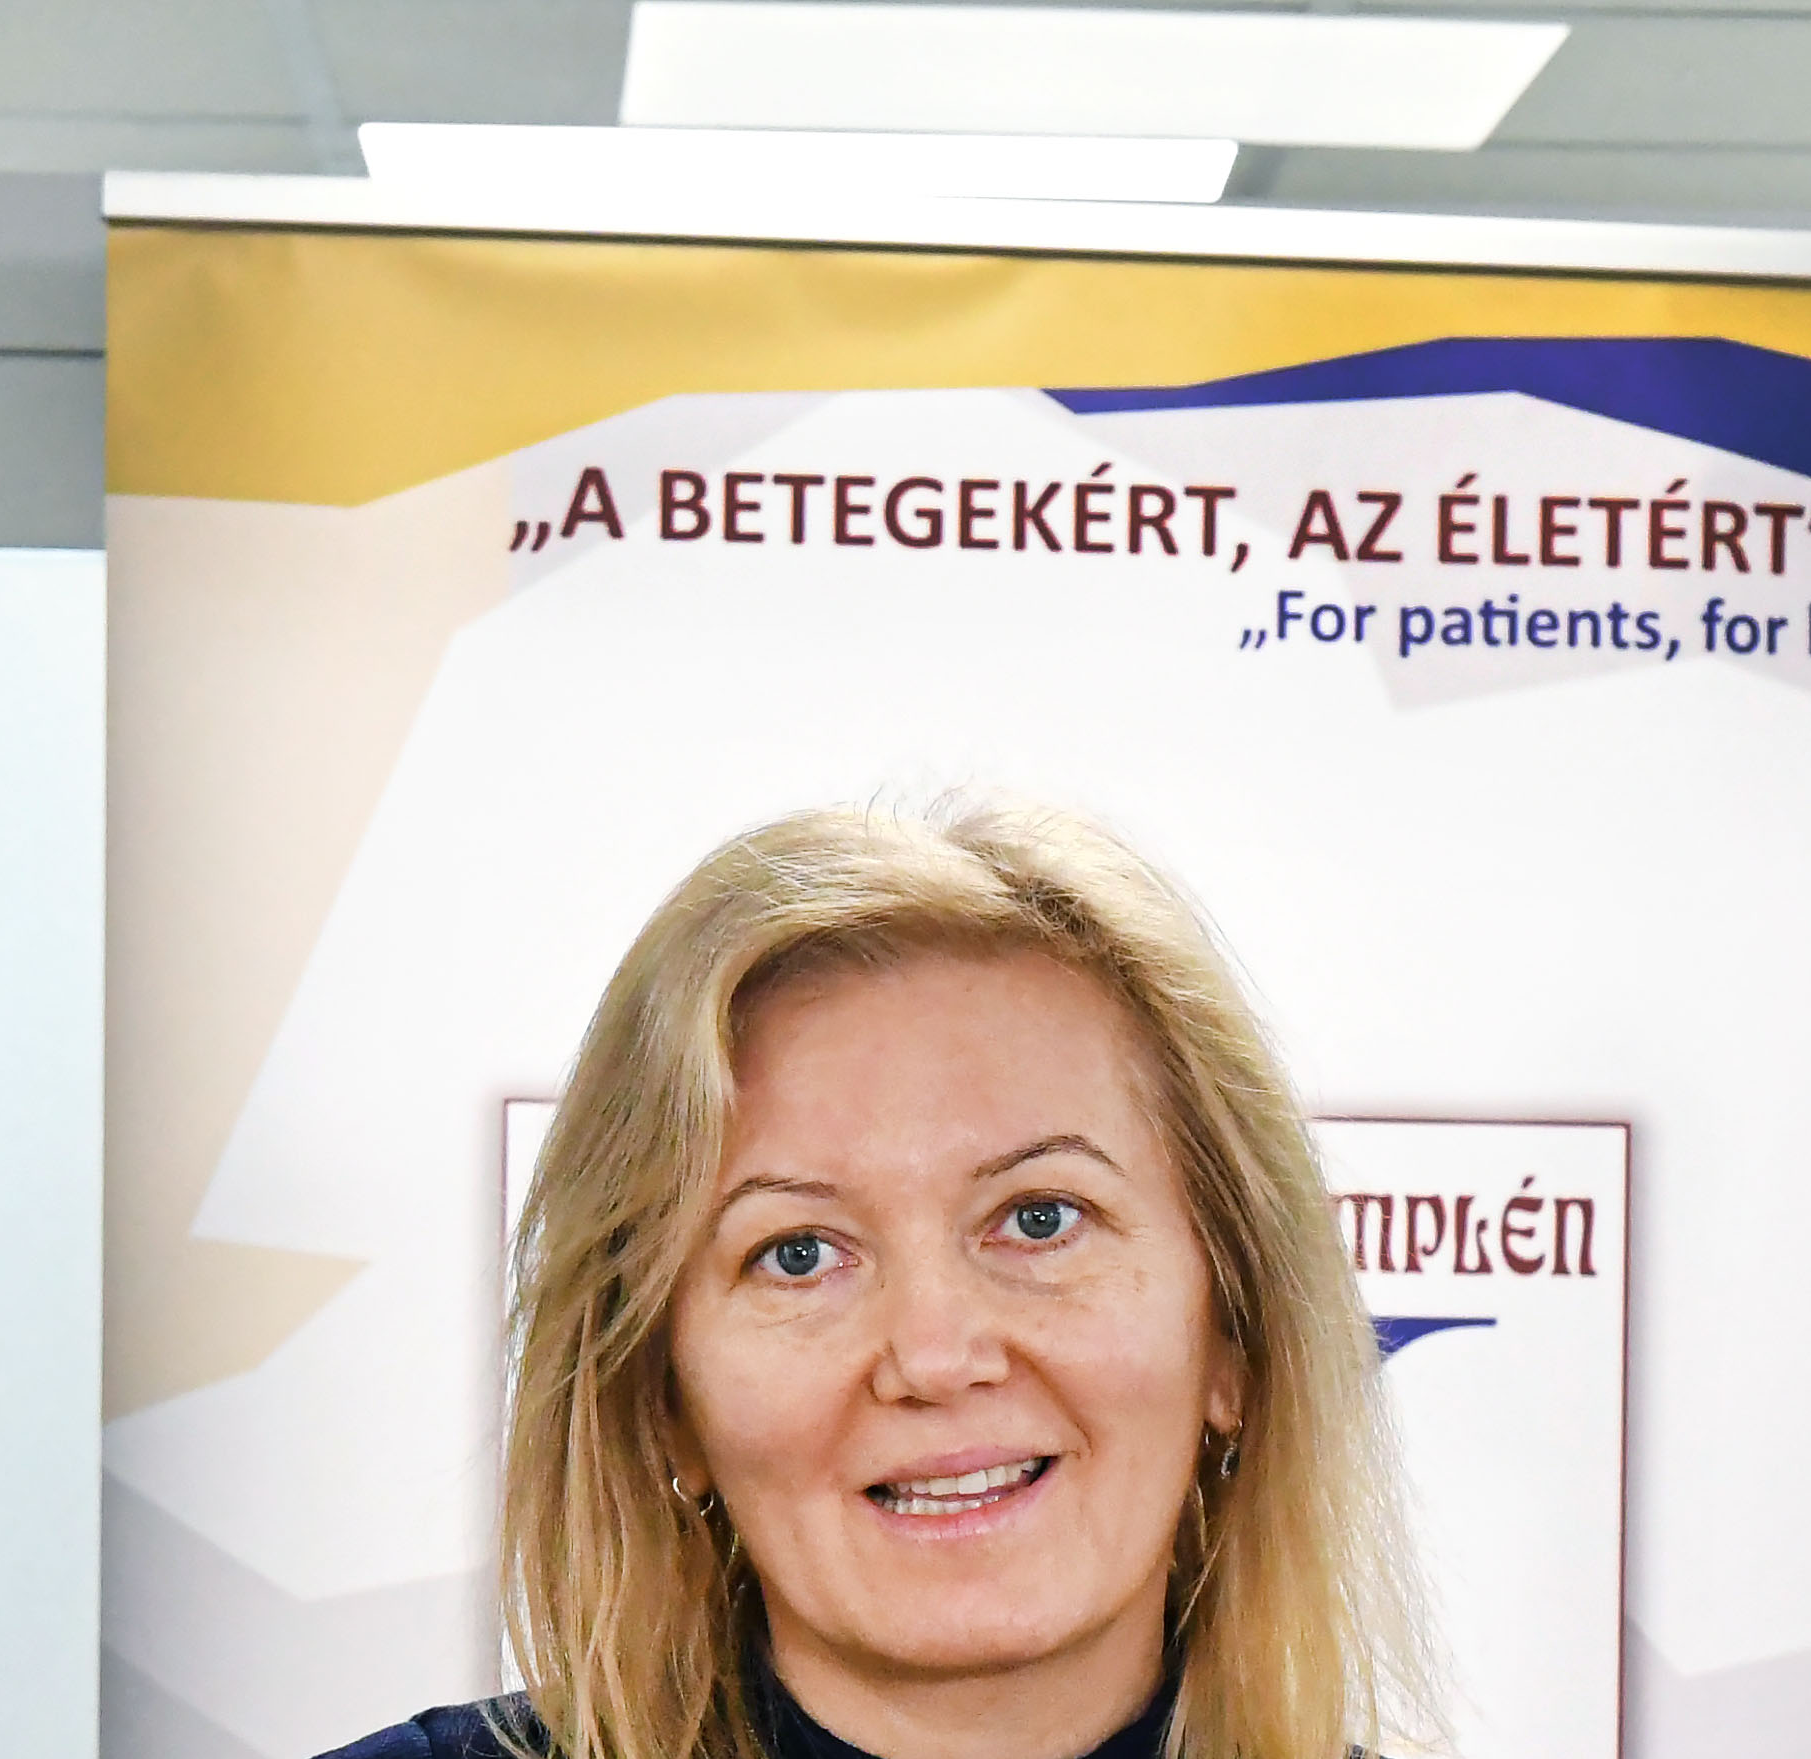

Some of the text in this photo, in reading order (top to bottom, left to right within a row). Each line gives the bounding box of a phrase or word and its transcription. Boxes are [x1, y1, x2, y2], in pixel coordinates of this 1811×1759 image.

[509, 466, 625, 553] „A
[659, 462, 1250, 573] BETEGEKÉRT,
[1287, 489, 1403, 562] AZ
[1239, 589, 1377, 650] „For
[1399, 594, 1681, 660] patients,
[1700, 597, 1789, 655] for
[1337, 1175, 1597, 1276] MPLÉN
